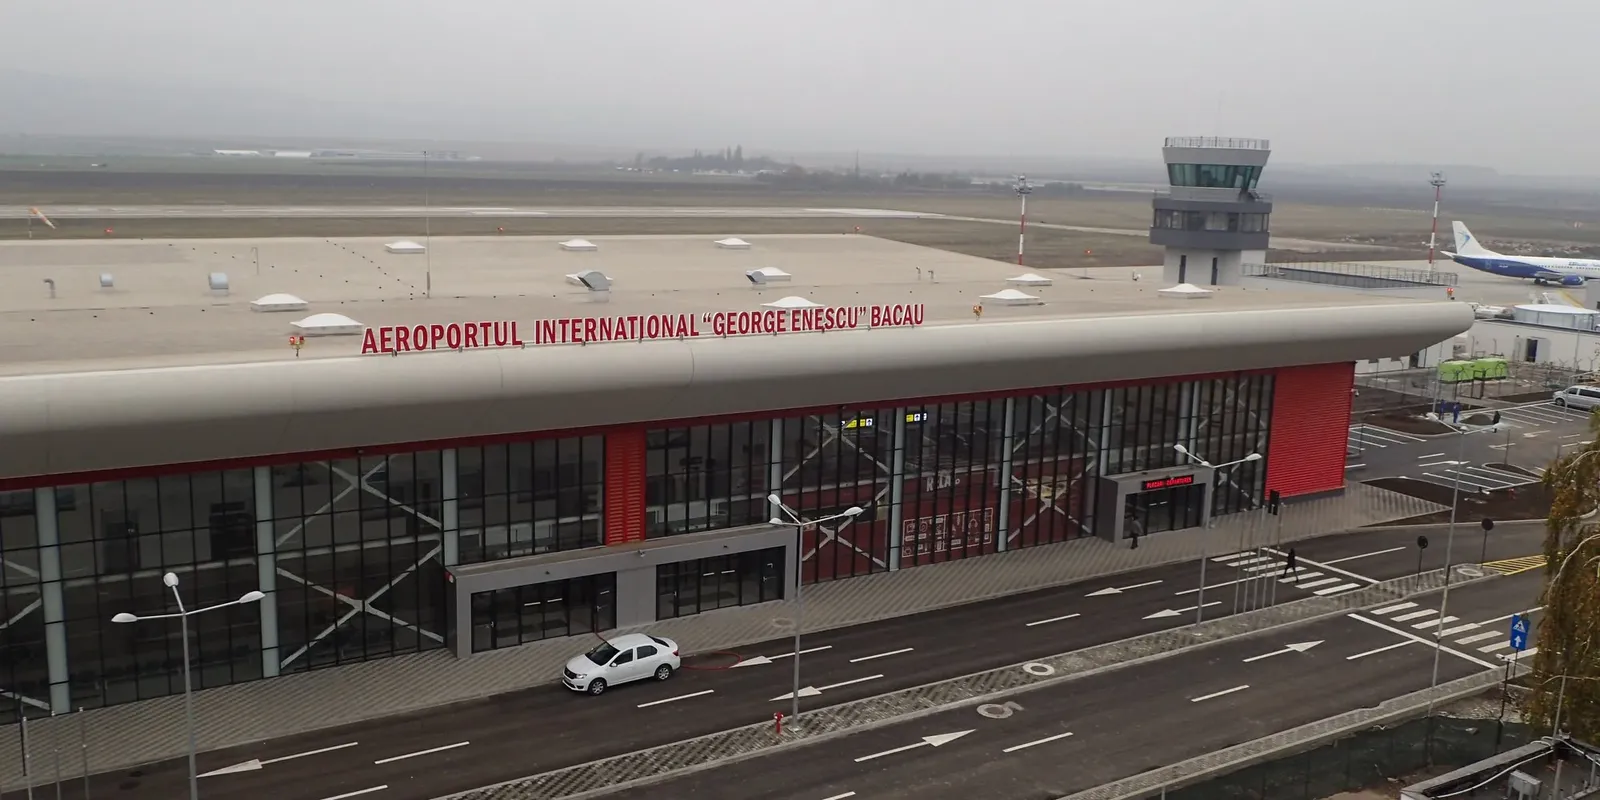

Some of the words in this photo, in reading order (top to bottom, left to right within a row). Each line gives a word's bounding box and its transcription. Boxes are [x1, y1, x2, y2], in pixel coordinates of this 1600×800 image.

[361, 321, 523, 354] AEROPORTUL
[535, 313, 699, 345] INTERNATIONAL
[702, 310, 787, 336] “GEORGE
[791, 306, 867, 332] ENESCU”
[870, 303, 925, 327] BACAU
